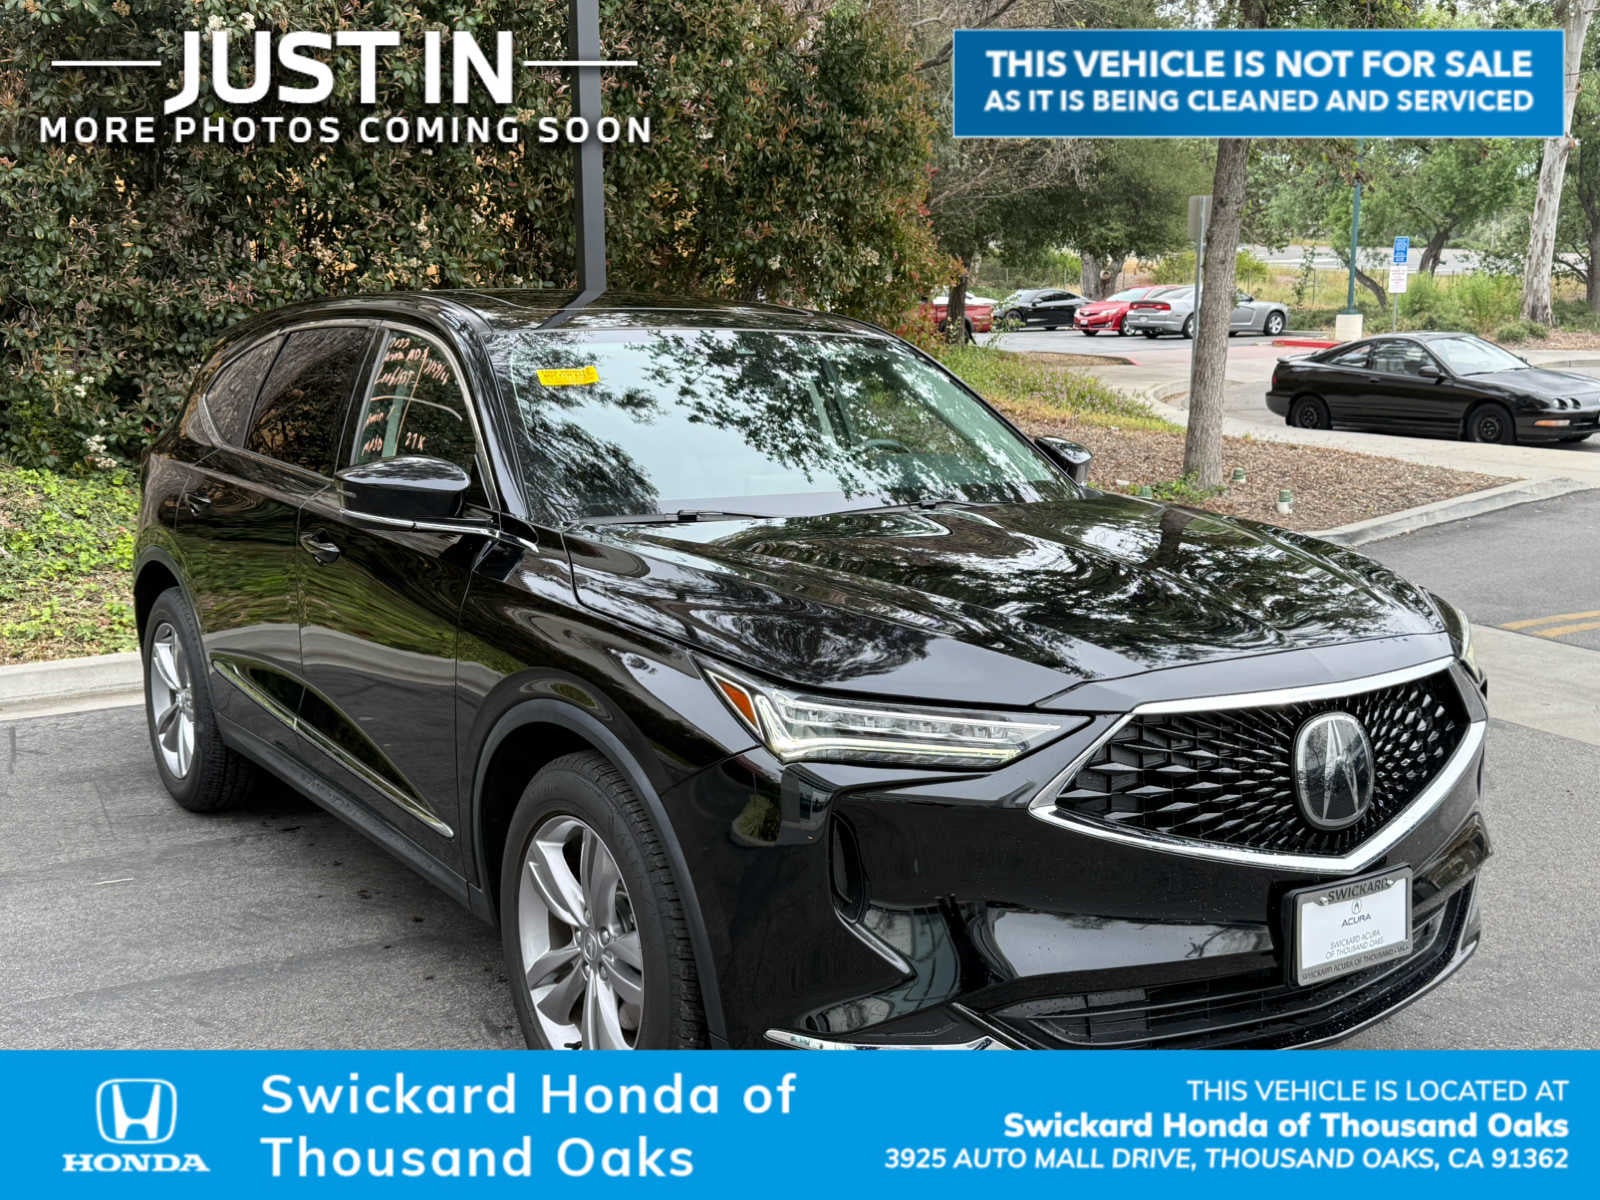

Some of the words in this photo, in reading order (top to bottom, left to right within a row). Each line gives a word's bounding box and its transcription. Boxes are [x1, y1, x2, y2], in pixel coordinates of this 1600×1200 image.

[1327, 878, 1391, 903] SWICKARD
[1341, 913, 1372, 928] ACURA
[1330, 935, 1361, 949] SWICKARD
